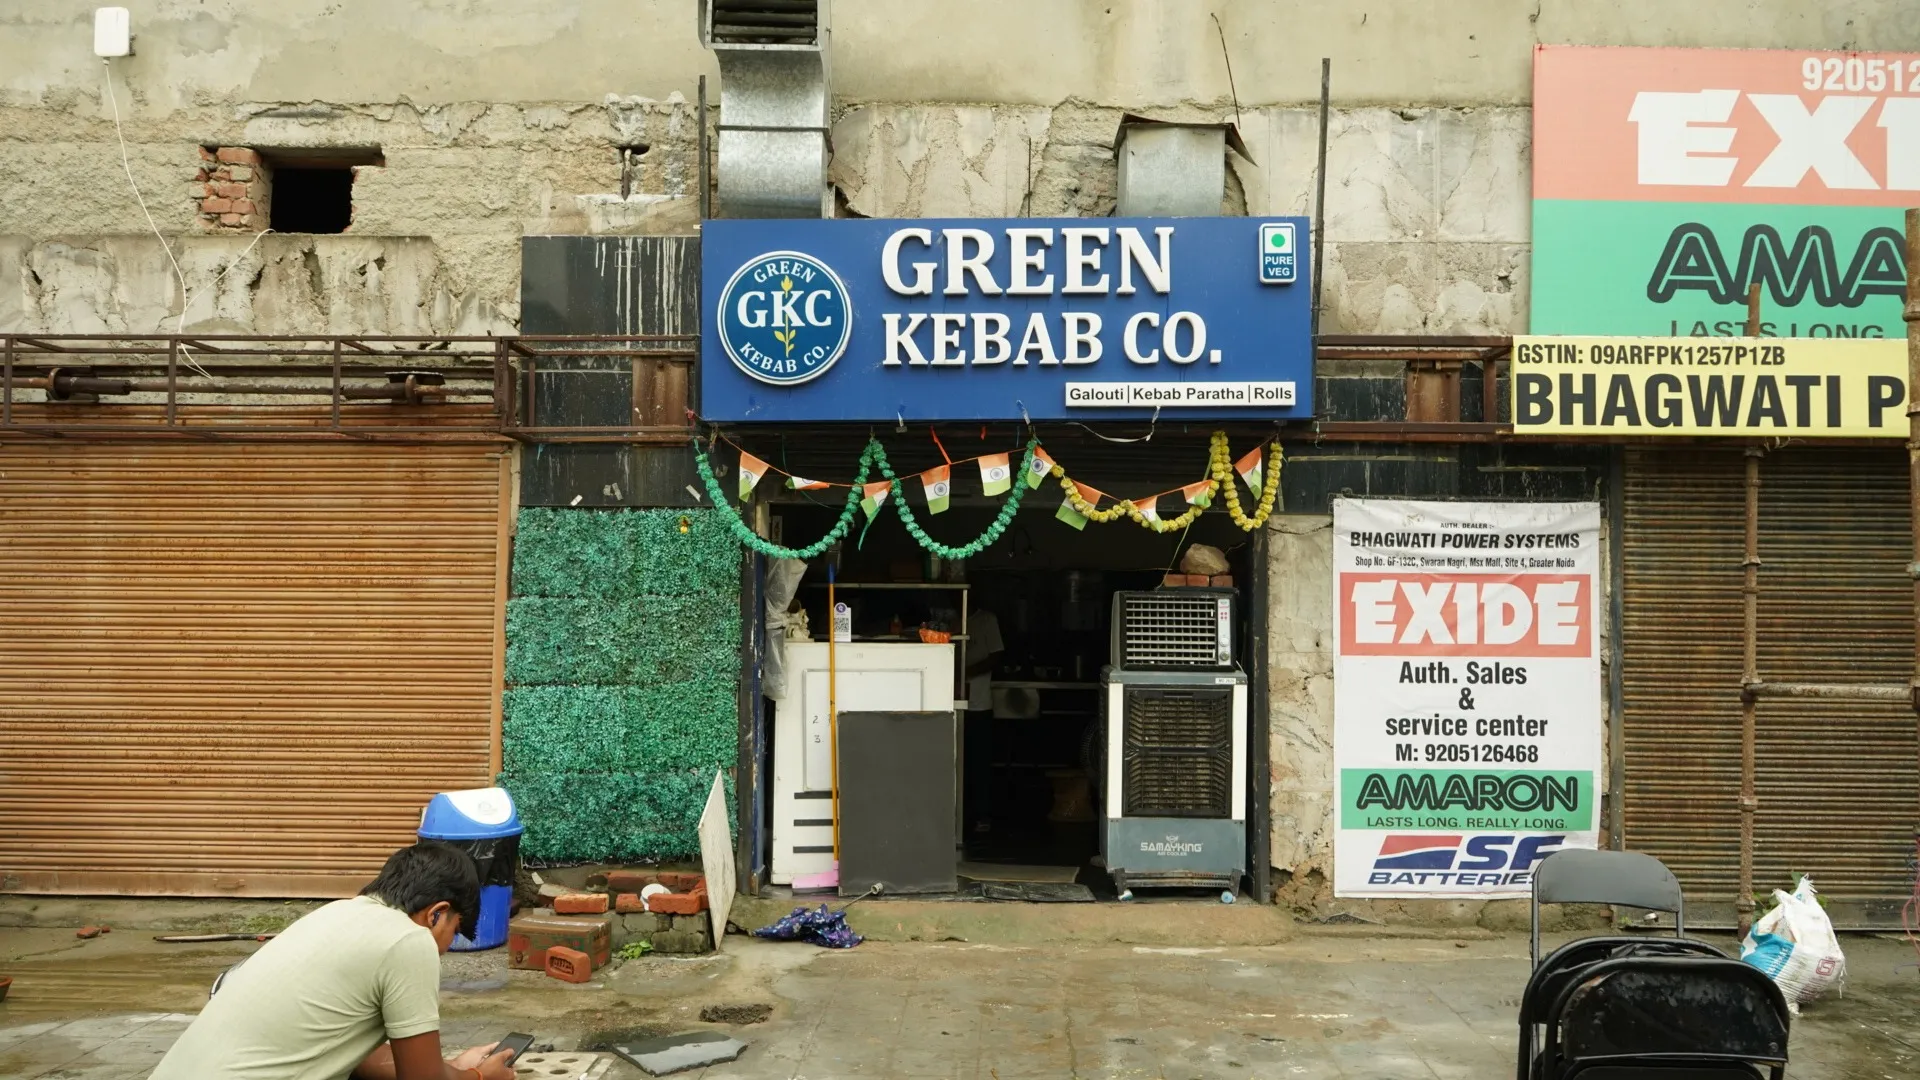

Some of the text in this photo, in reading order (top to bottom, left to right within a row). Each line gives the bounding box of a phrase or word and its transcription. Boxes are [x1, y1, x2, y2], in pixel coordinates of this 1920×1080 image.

[1802, 57, 1920, 92] 920512
[754, 260, 816, 283] GREEN
[881, 226, 1175, 295] GREEN
[1265, 256, 1293, 265] PURE
[1268, 267, 1290, 276] VEG
[737, 290, 832, 328] GKC
[882, 311, 1222, 366] KEBAB CO.
[739, 342, 830, 373] KEBAB CO.
[1517, 343, 1785, 366] GSTIN: 09ARFPK1257P1ZB
[1070, 387, 1292, 400] Galouti Kebab Paratha Rolls
[1515, 372, 1906, 428] BHAGWATI P
[1351, 531, 1580, 549] BHAGWATI POWER SYSTEMS
[1355, 556, 1372, 568] Shop
[1374, 556, 1385, 566] No.
[1420, 557, 1445, 567] Swaran
[1469, 557, 1483, 567] Msx
[1505, 557, 1518, 567] Site
[1529, 557, 1554, 567] Greater
[1556, 557, 1575, 567] Noida
[1351, 579, 1580, 645] EXIDE
[1399, 661, 1527, 685] Auth. Sales
[1458, 687, 1475, 710] &
[1385, 714, 1548, 736] service center
[1395, 744, 1539, 762] M: 9205126468
[1356, 773, 1578, 812] AMARON
[1367, 816, 1568, 829] LASTS LONG. REALLY LONG.
[1140, 842, 1202, 852] SAMAYKING
[1458, 835, 1566, 871] SF
[1368, 872, 1534, 886] BATTERIE
